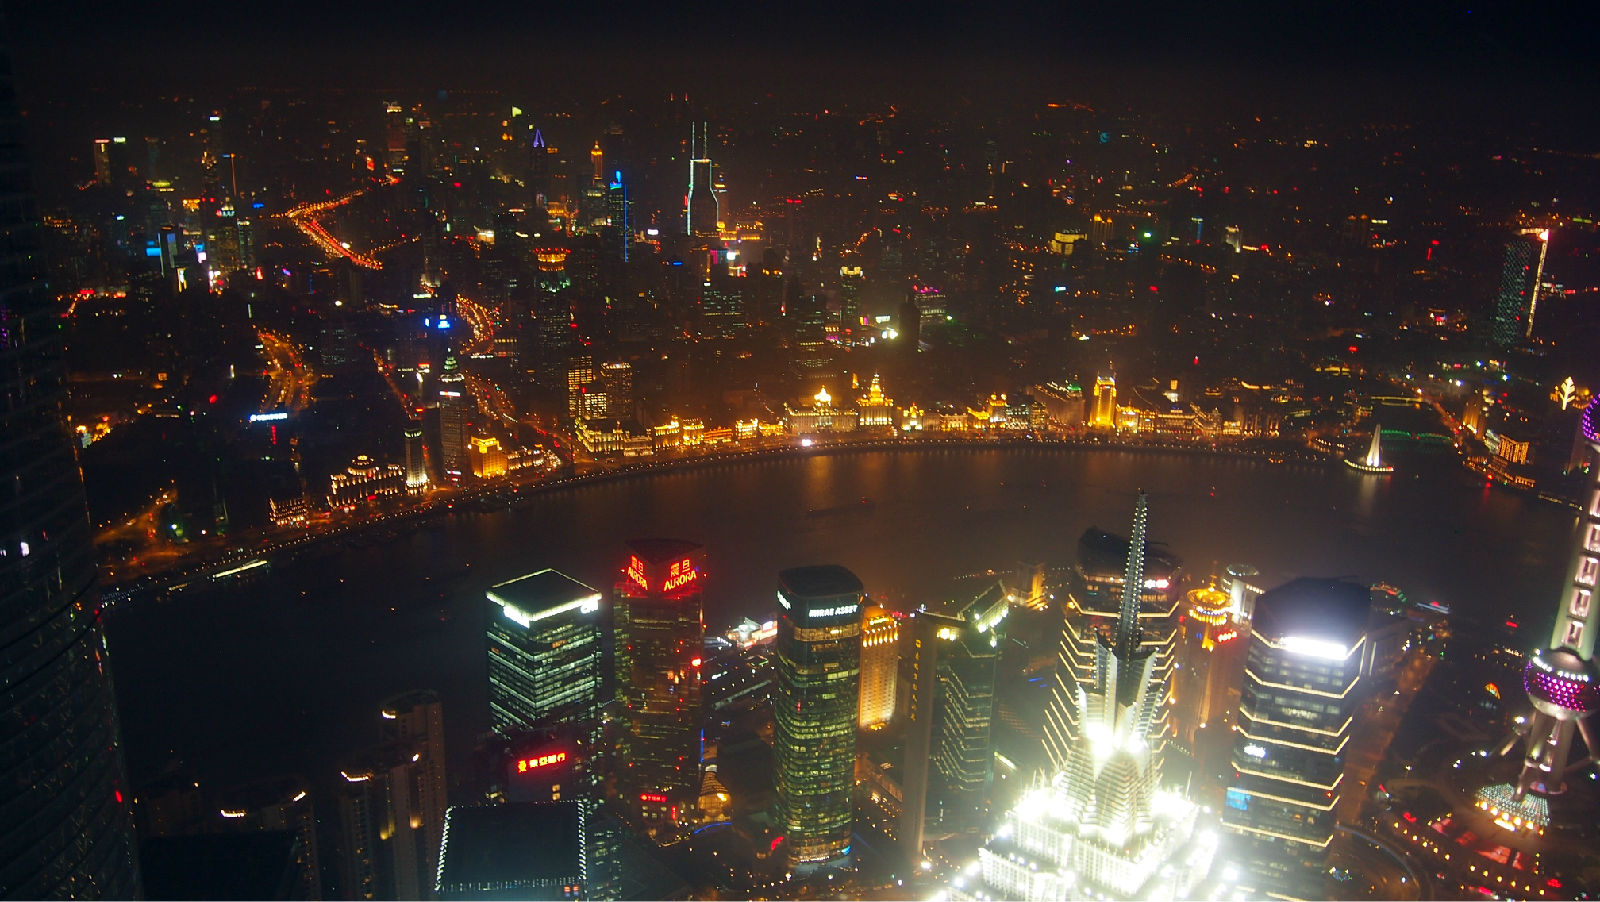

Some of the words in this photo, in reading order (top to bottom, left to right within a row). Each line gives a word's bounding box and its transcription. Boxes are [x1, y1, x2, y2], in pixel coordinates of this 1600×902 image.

[628, 566, 648, 591] AURORA
[663, 570, 697, 592] AURORA
[835, 605, 858, 615] ASSET
